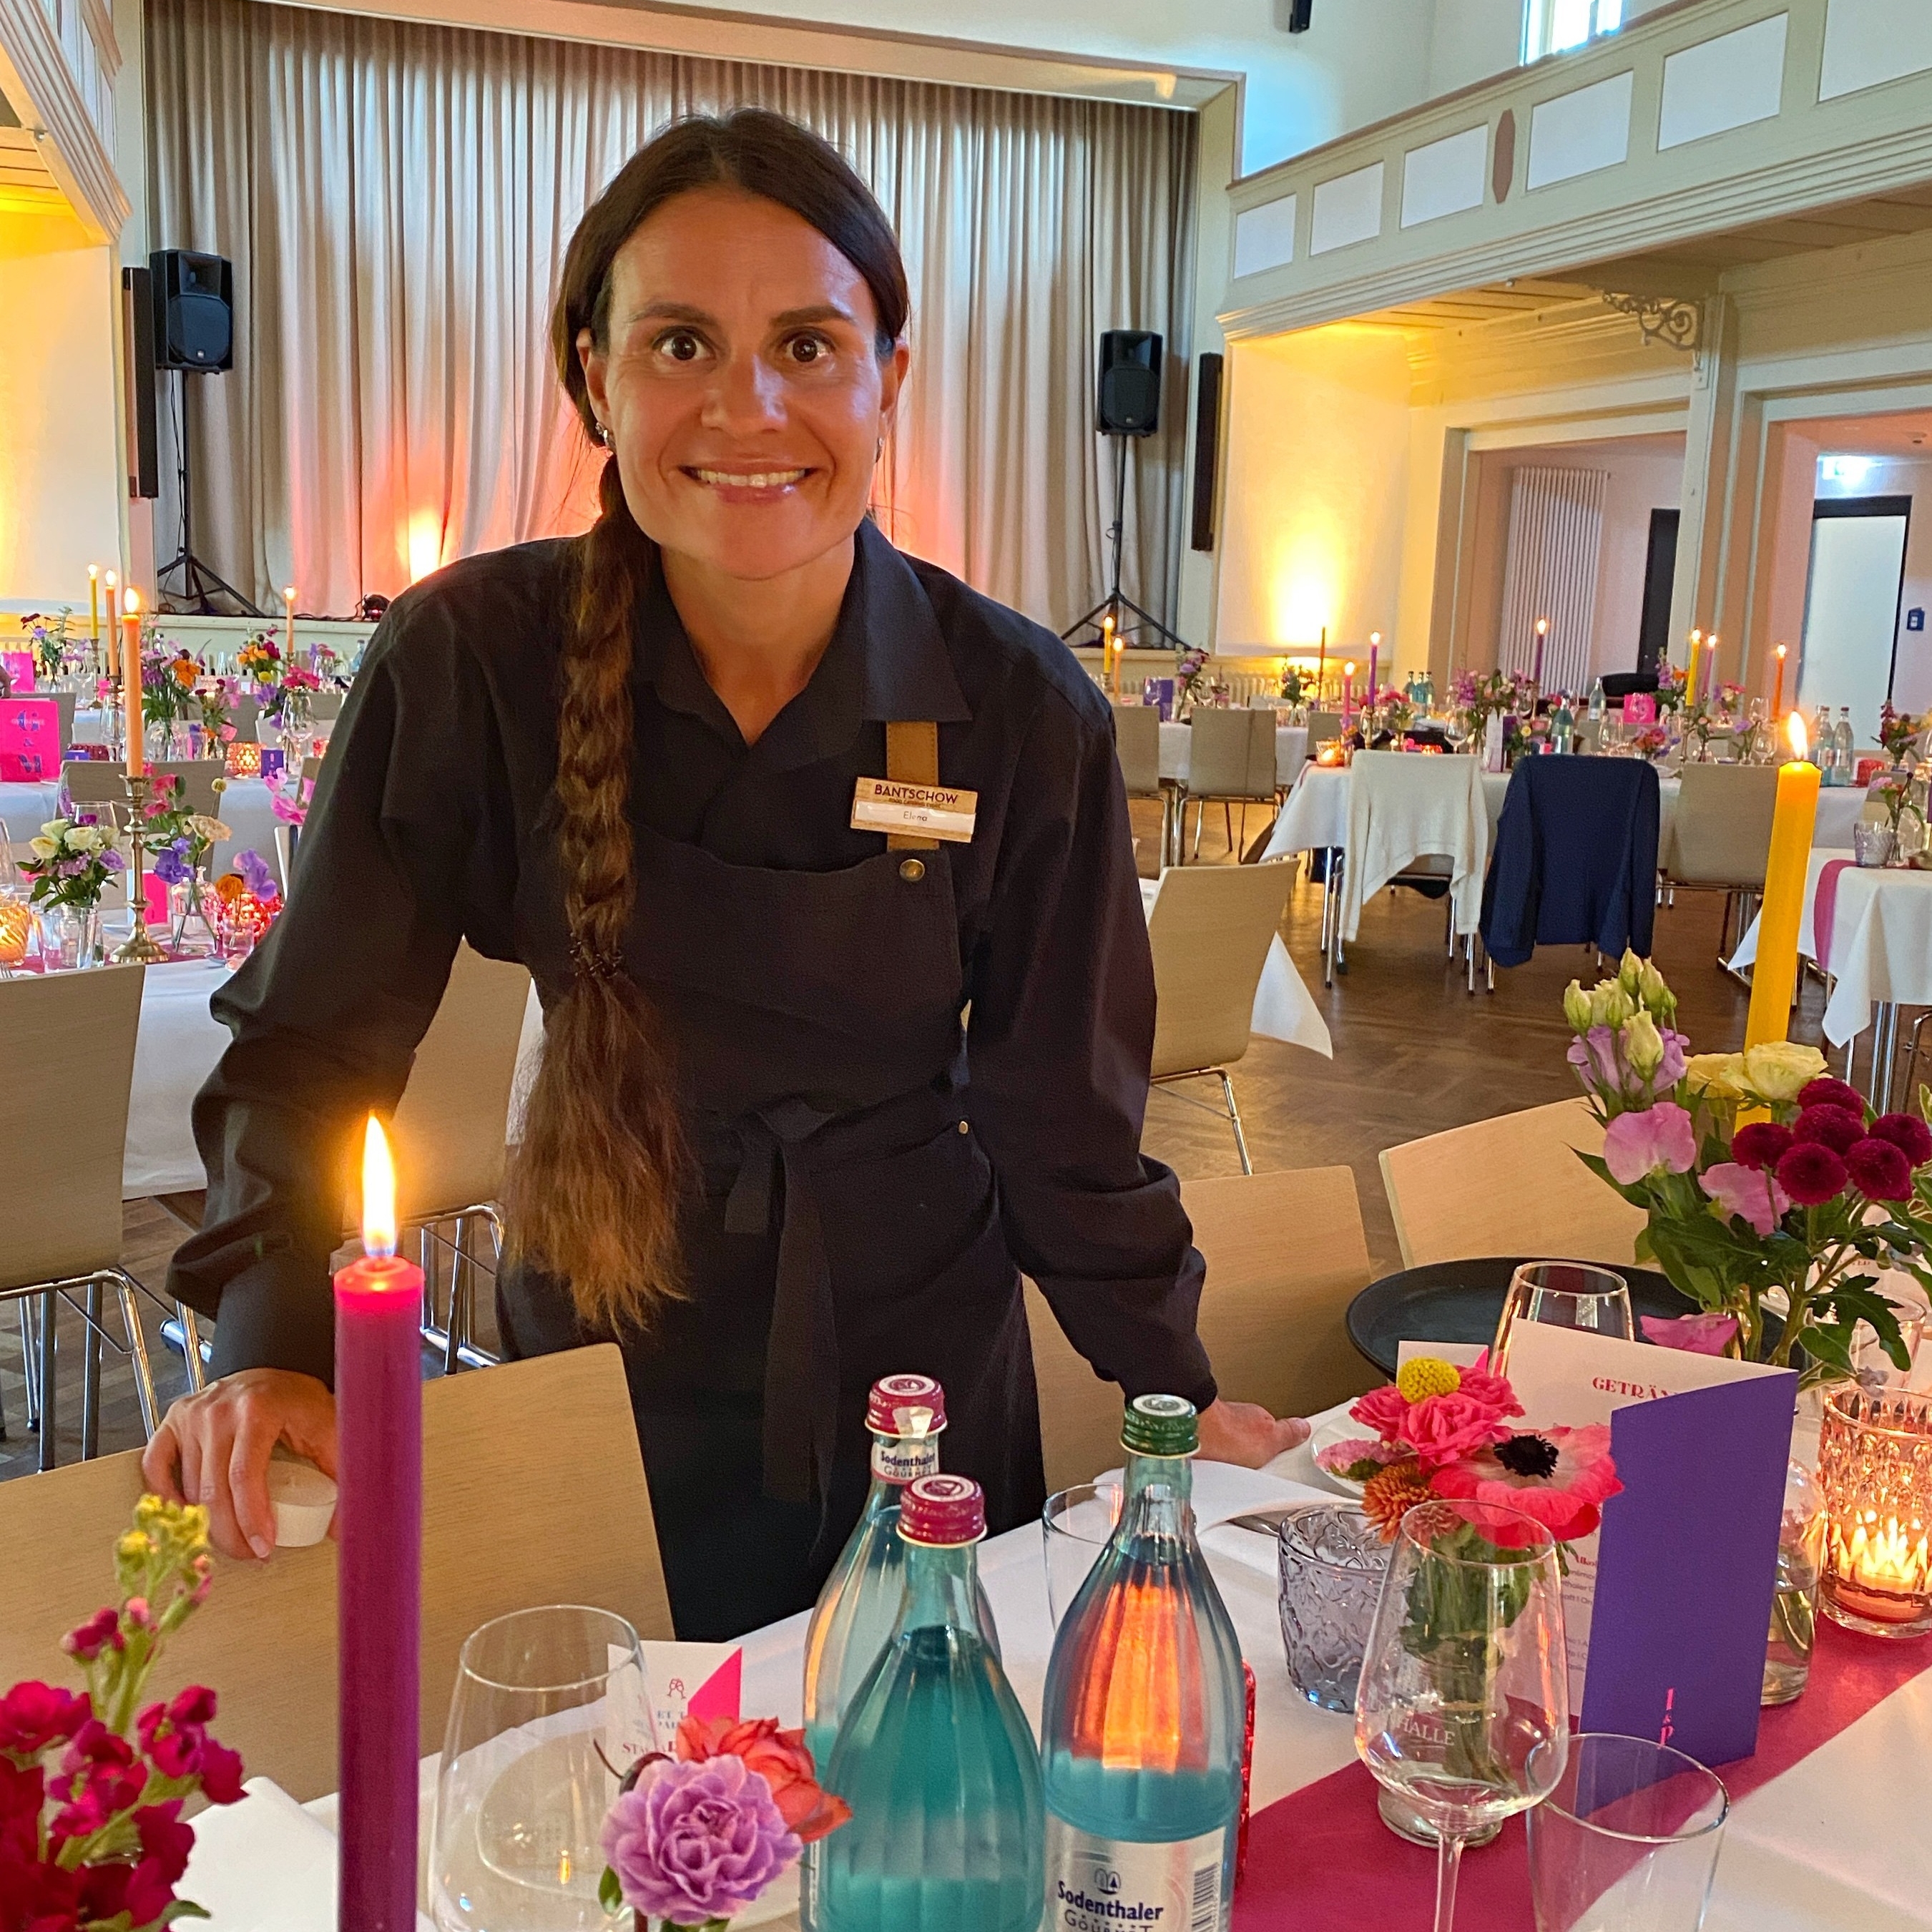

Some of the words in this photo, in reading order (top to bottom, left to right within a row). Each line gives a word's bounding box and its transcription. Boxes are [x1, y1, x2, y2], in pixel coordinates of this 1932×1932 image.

[874, 784, 958, 805] BANTSCHOW
[903, 810, 928, 822] Elena
[881, 1450, 936, 1466] Sodenthaler
[1057, 1880, 1164, 1921] Sodenthaler
